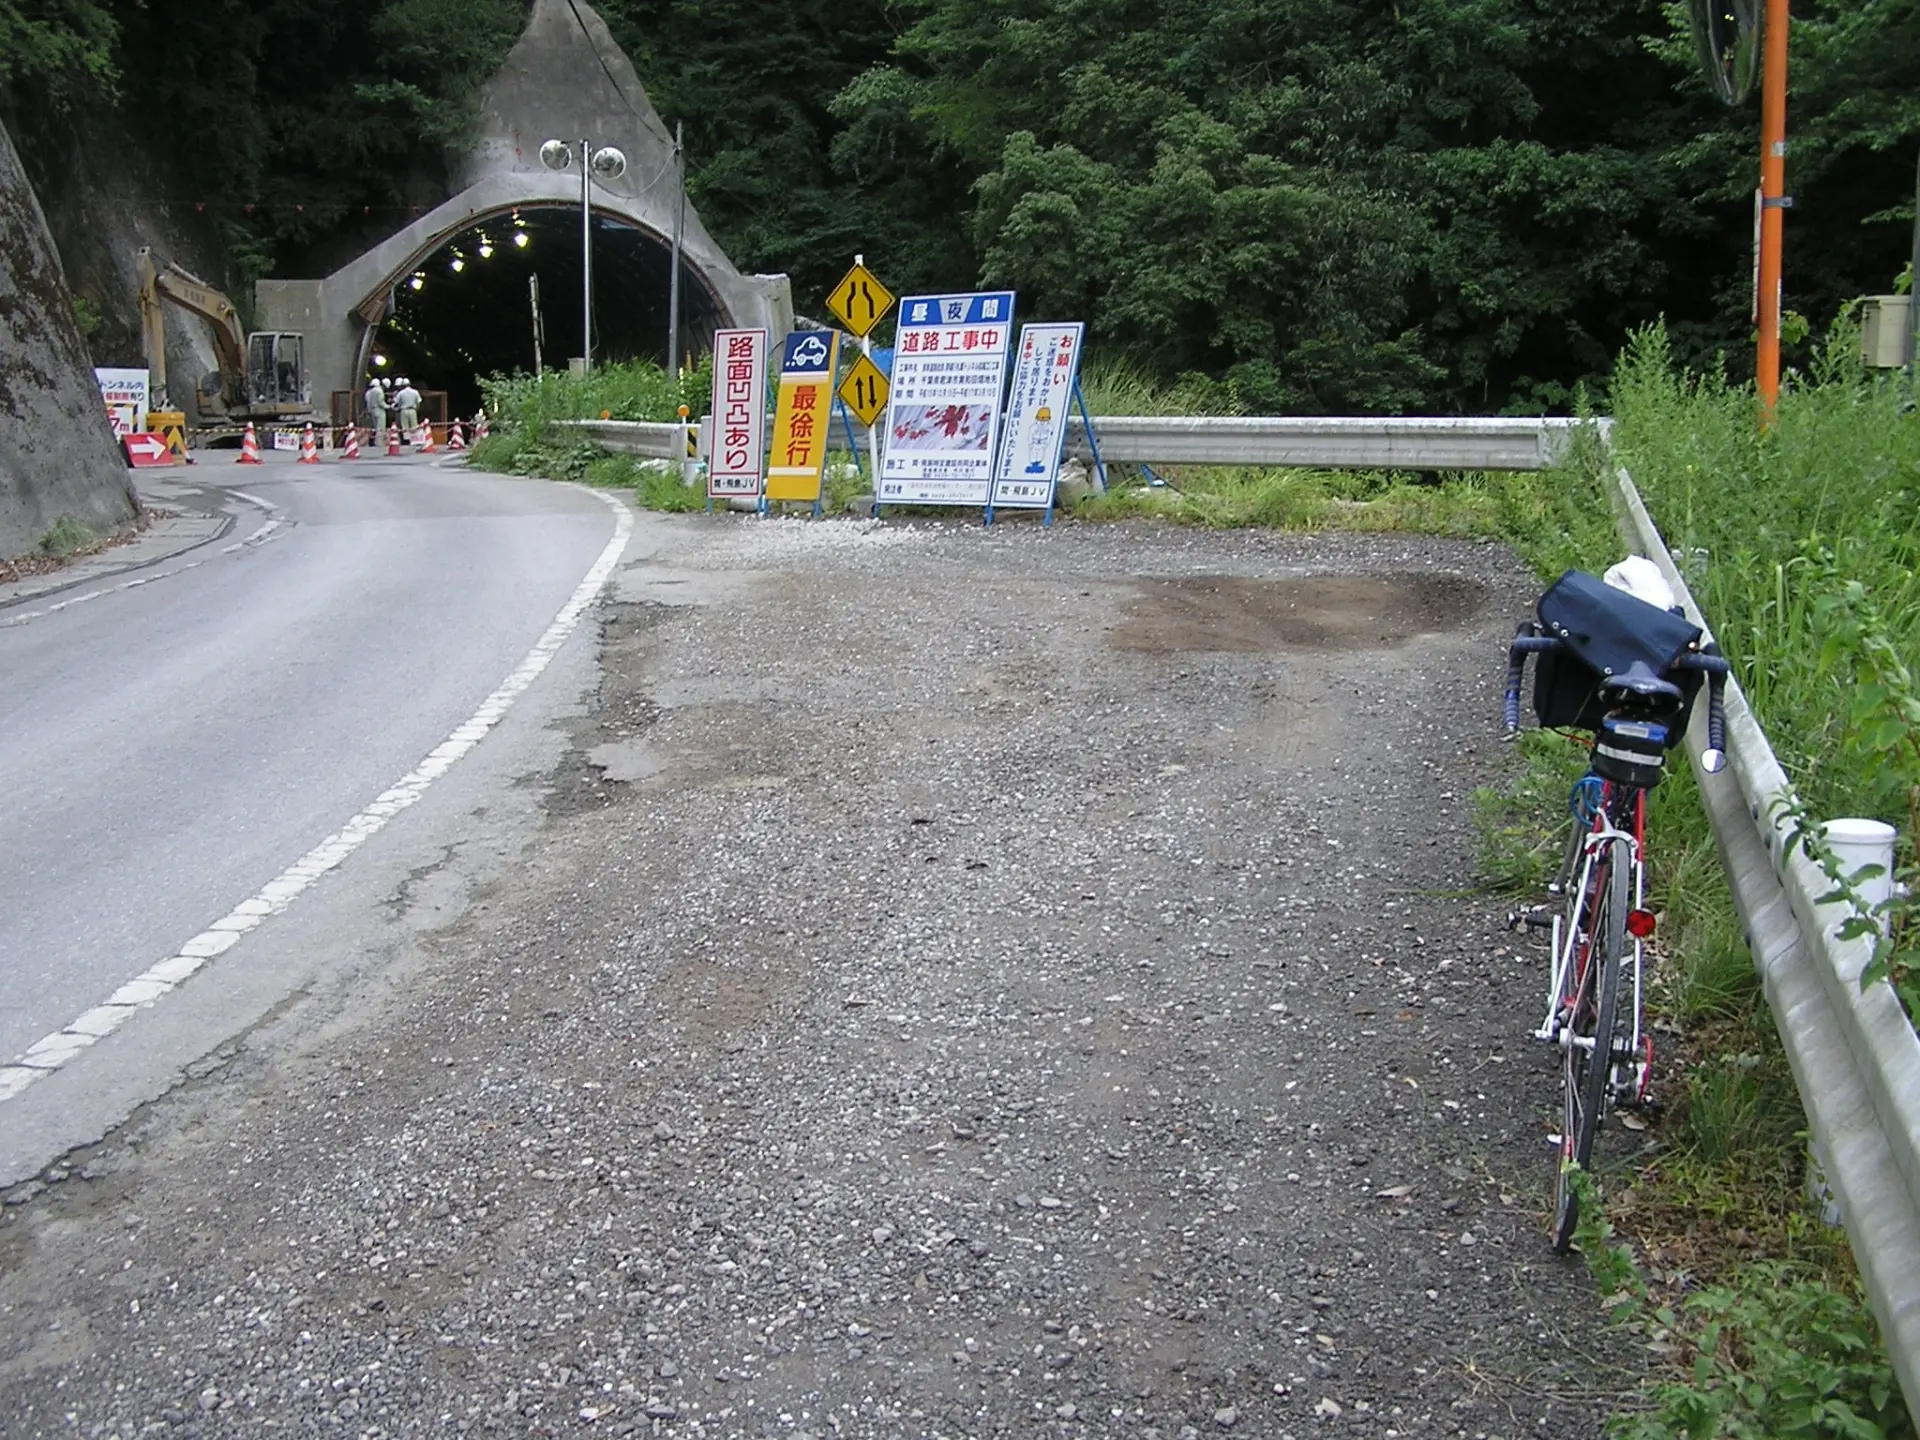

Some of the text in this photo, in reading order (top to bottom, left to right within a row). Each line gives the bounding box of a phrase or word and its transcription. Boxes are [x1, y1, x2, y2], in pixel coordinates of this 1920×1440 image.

[902, 329, 998, 353] 道路工事中
[1053, 335, 1073, 385] お願い
[725, 337, 753, 469] 路面凹凸あり
[786, 385, 818, 466] 最徐行
